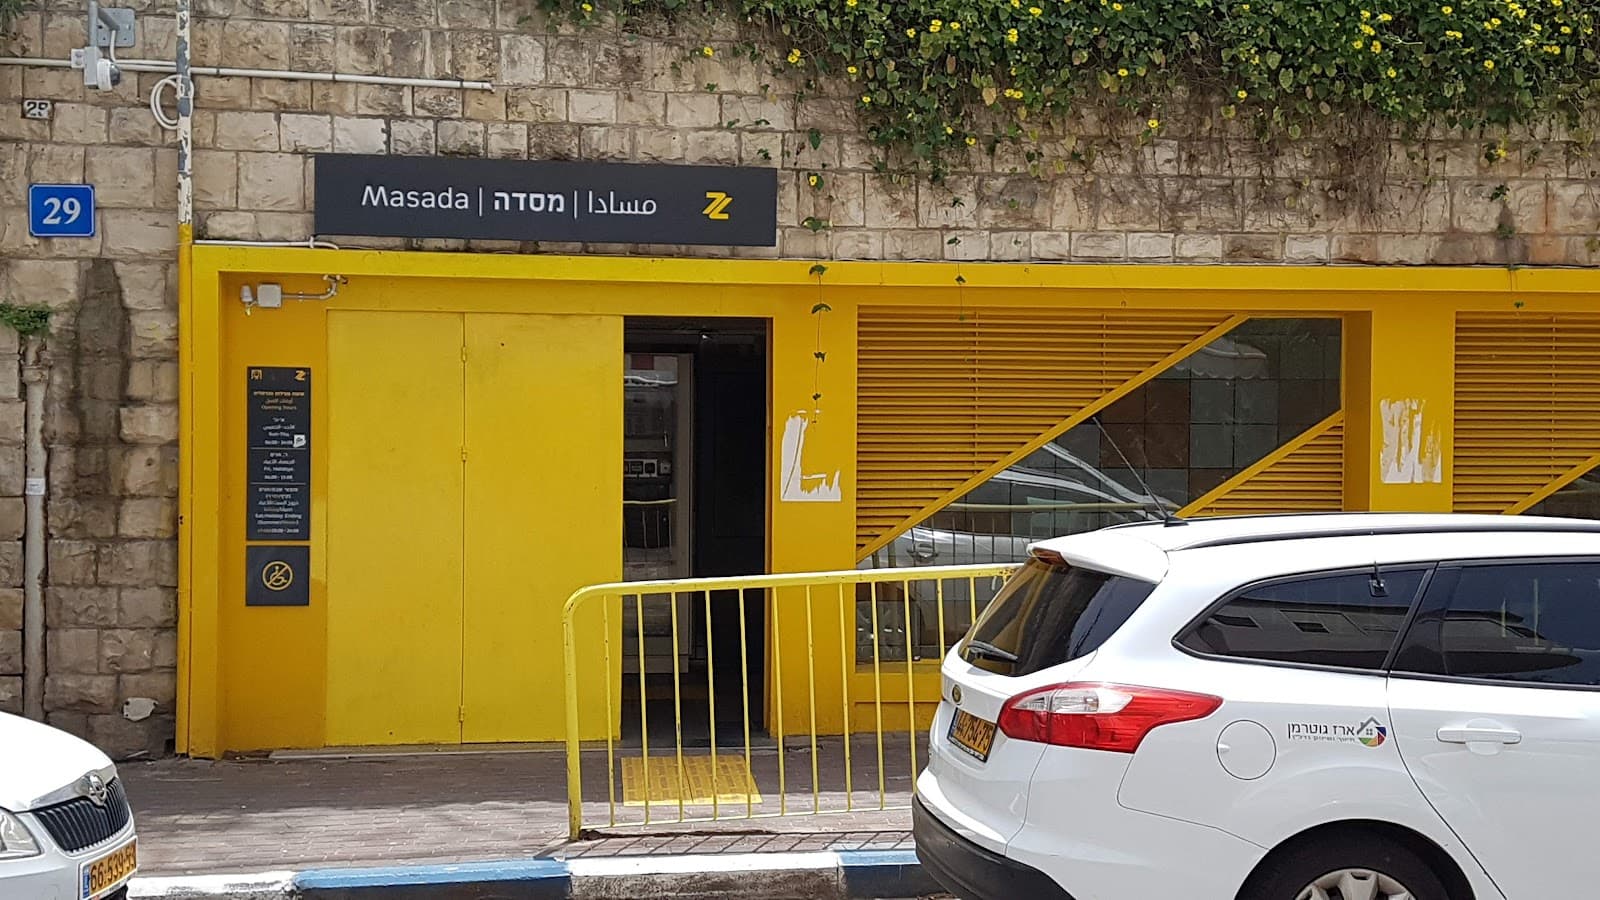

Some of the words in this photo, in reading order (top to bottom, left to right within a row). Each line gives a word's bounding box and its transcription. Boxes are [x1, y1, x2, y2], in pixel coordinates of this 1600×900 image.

[361, 184, 470, 211] Masada
[493, 190, 565, 213] מסדה
[587, 190, 657, 216] مسادا
[42, 197, 81, 225] 29
[1287, 723, 1328, 740] גוטרמן
[1332, 725, 1355, 736] ארז
